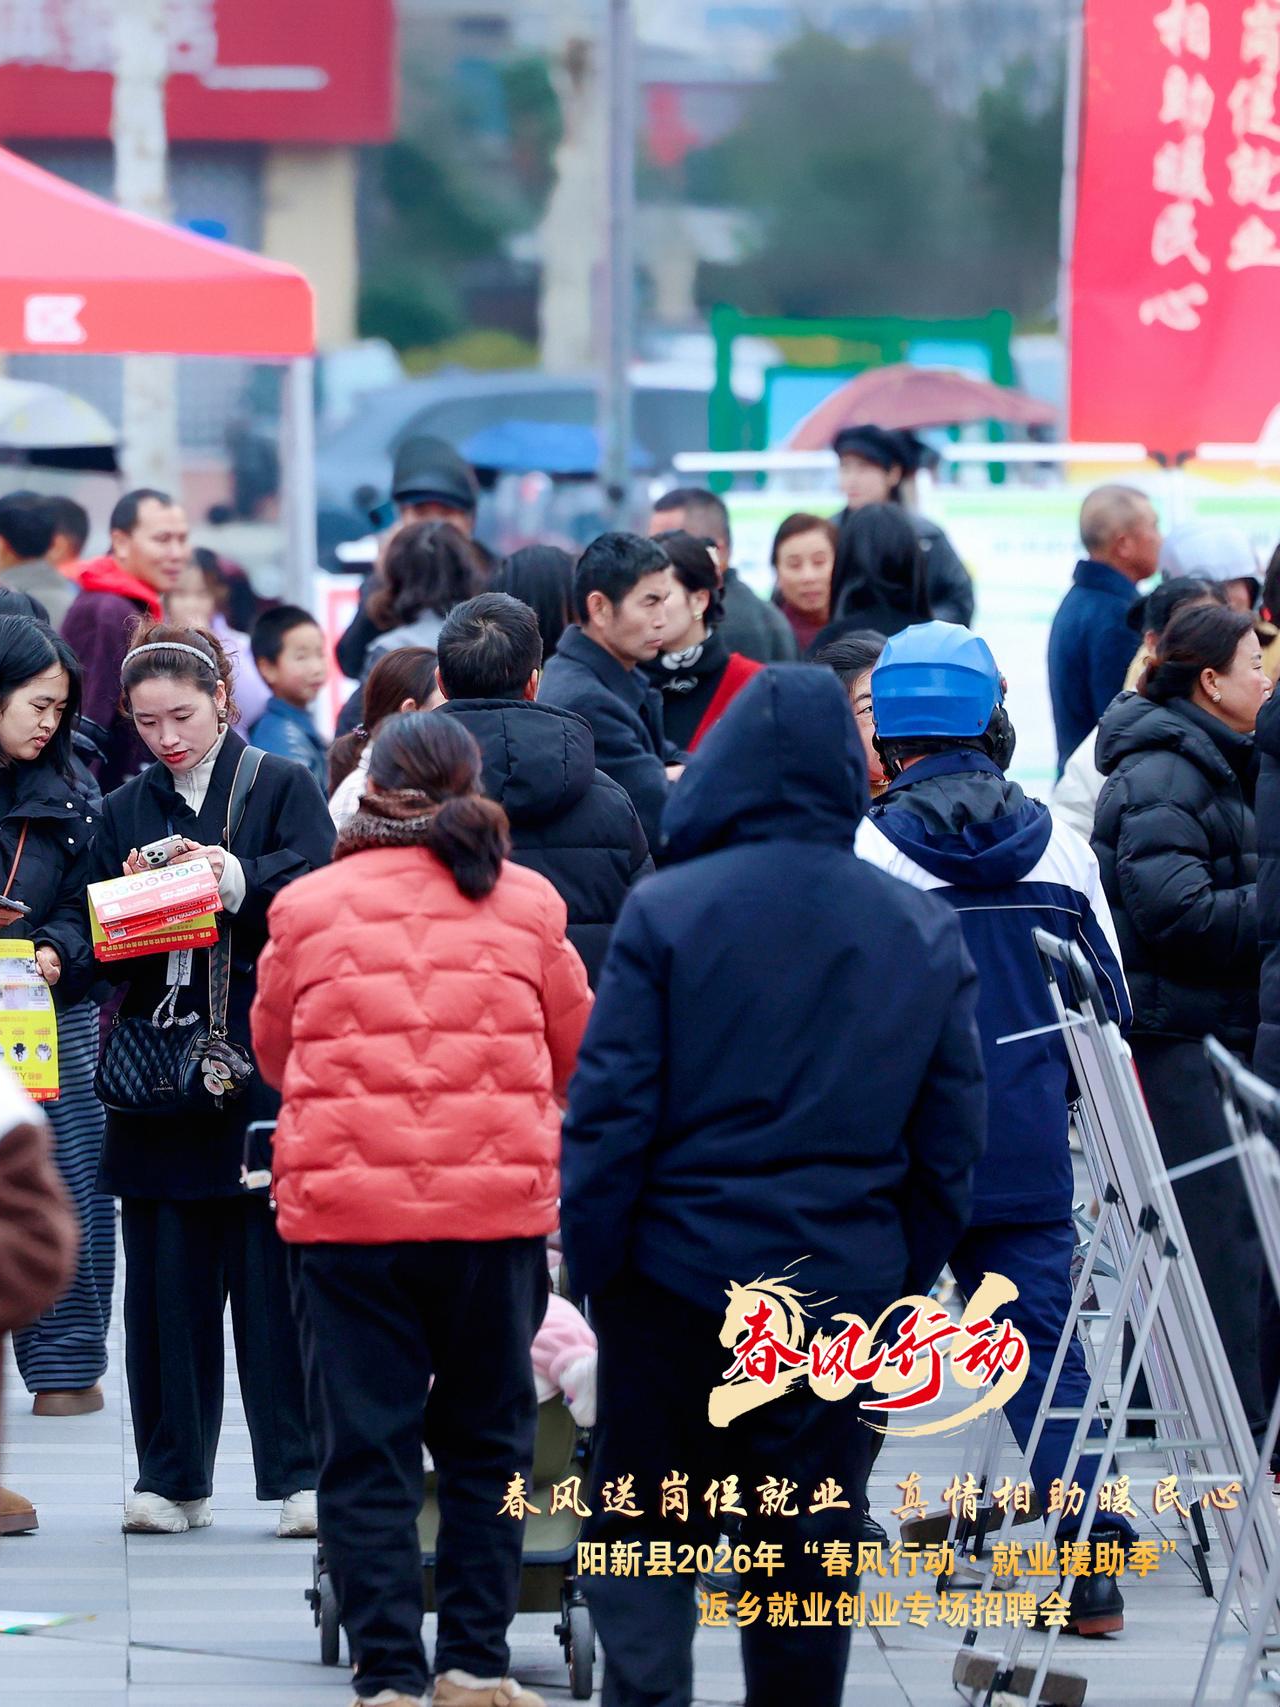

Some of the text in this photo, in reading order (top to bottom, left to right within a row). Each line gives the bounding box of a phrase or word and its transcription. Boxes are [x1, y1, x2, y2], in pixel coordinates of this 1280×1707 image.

[1139, 0, 1214, 332] 相助暖民心
